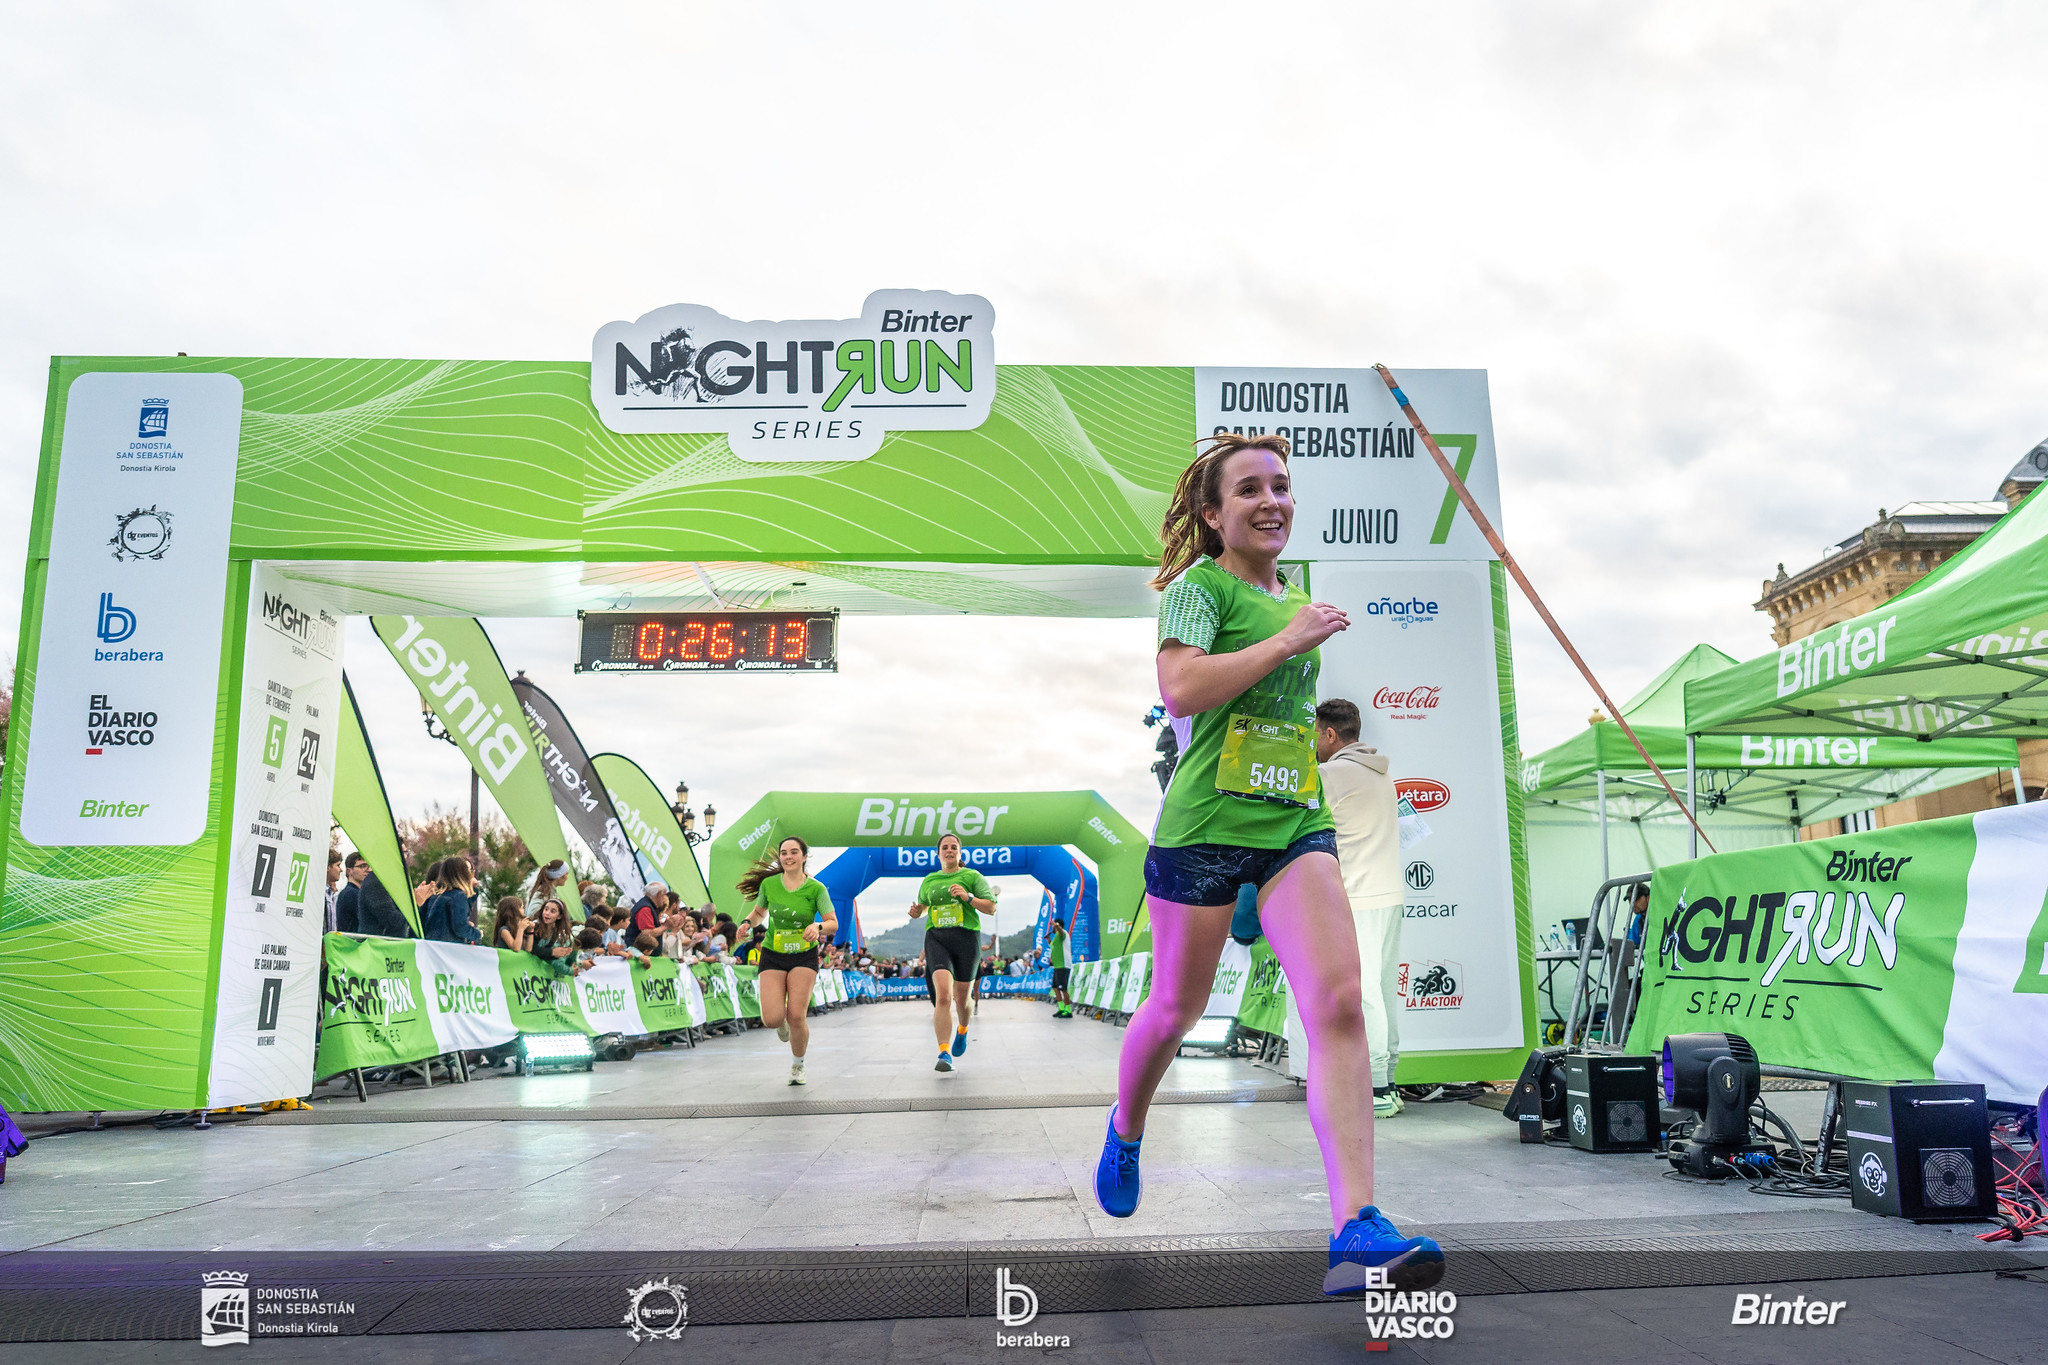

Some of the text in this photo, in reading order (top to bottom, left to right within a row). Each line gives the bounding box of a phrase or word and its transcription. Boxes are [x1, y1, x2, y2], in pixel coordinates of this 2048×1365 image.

[881, 309, 973, 333] Binter
[1221, 382, 1349, 413] DONOSTIA
[751, 420, 863, 439] SERIES
[130, 442, 172, 450] DONOSTIA
[137, 450, 184, 459] SEBASTIÁN
[1430, 434, 1477, 544] 7
[1323, 508, 1398, 544] JUNIO
[1367, 597, 1439, 615] añarbe
[319, 609, 338, 627] Binter
[1415, 616, 1434, 624] aguas
[639, 622, 806, 659] 0:26:13
[94, 648, 164, 661] berabera
[291, 645, 307, 659] SERIES
[1776, 615, 1896, 698] Binter
[267, 679, 293, 699] SANTA CRUZ
[1373, 686, 1443, 709] Coca-Cola
[90, 695, 112, 710] EL
[265, 693, 291, 713] DE TENERIFE
[306, 704, 319, 718] PALMA
[88, 712, 158, 727] DIARIO
[1234, 718, 1252, 731] 5K
[88, 730, 154, 745] VASCO
[269, 724, 282, 761] 5
[298, 736, 318, 775] 24
[1740, 736, 1878, 767] Binter
[266, 771, 276, 783] ABRIL
[1249, 762, 1299, 793] 5493
[300, 782, 309, 794] MAYO
[80, 800, 149, 817] Binter
[258, 809, 280, 825] DONOSTIA
[855, 798, 1009, 837] Binter
[251, 823, 283, 841] SAN SEBASTIÁN
[292, 826, 312, 840] ZARAGOZA
[738, 819, 772, 851] Binter
[1088, 816, 1122, 845] Binter
[258, 853, 271, 891] 7
[1827, 850, 1912, 882] Binter
[288, 860, 308, 897] 27
[1408, 863, 1432, 888] MG
[255, 903, 265, 913] JUNIO
[261, 944, 287, 956] LAS PALMAS
[784, 942, 800, 951] 5519
[254, 959, 291, 972] DE GRAN CANARIA
[385, 957, 405, 973] Binter
[434, 973, 492, 1014] Binter
[585, 983, 626, 1013] Binter
[1406, 996, 1463, 1008] LA FACTORY
[265, 986, 275, 1024] 1
[1687, 991, 1799, 1020] SERIES
[366, 1029, 401, 1042] SEES
